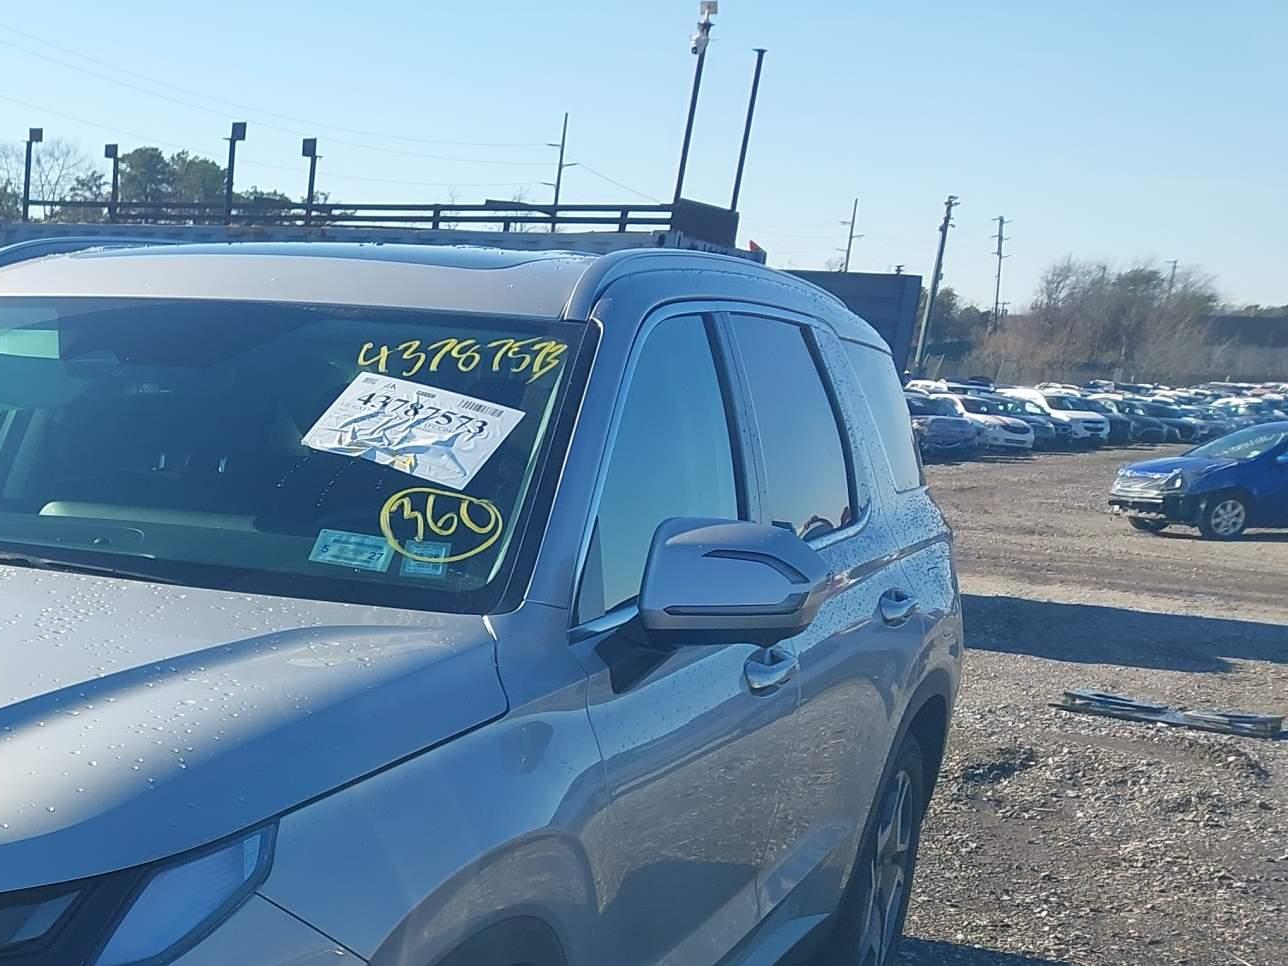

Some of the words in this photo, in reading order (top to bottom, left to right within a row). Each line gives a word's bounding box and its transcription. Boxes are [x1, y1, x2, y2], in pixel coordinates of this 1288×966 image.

[357, 337, 568, 384] 43787573
[357, 391, 489, 436] 43787573
[389, 493, 496, 542] 360
[367, 551, 385, 561] 27
